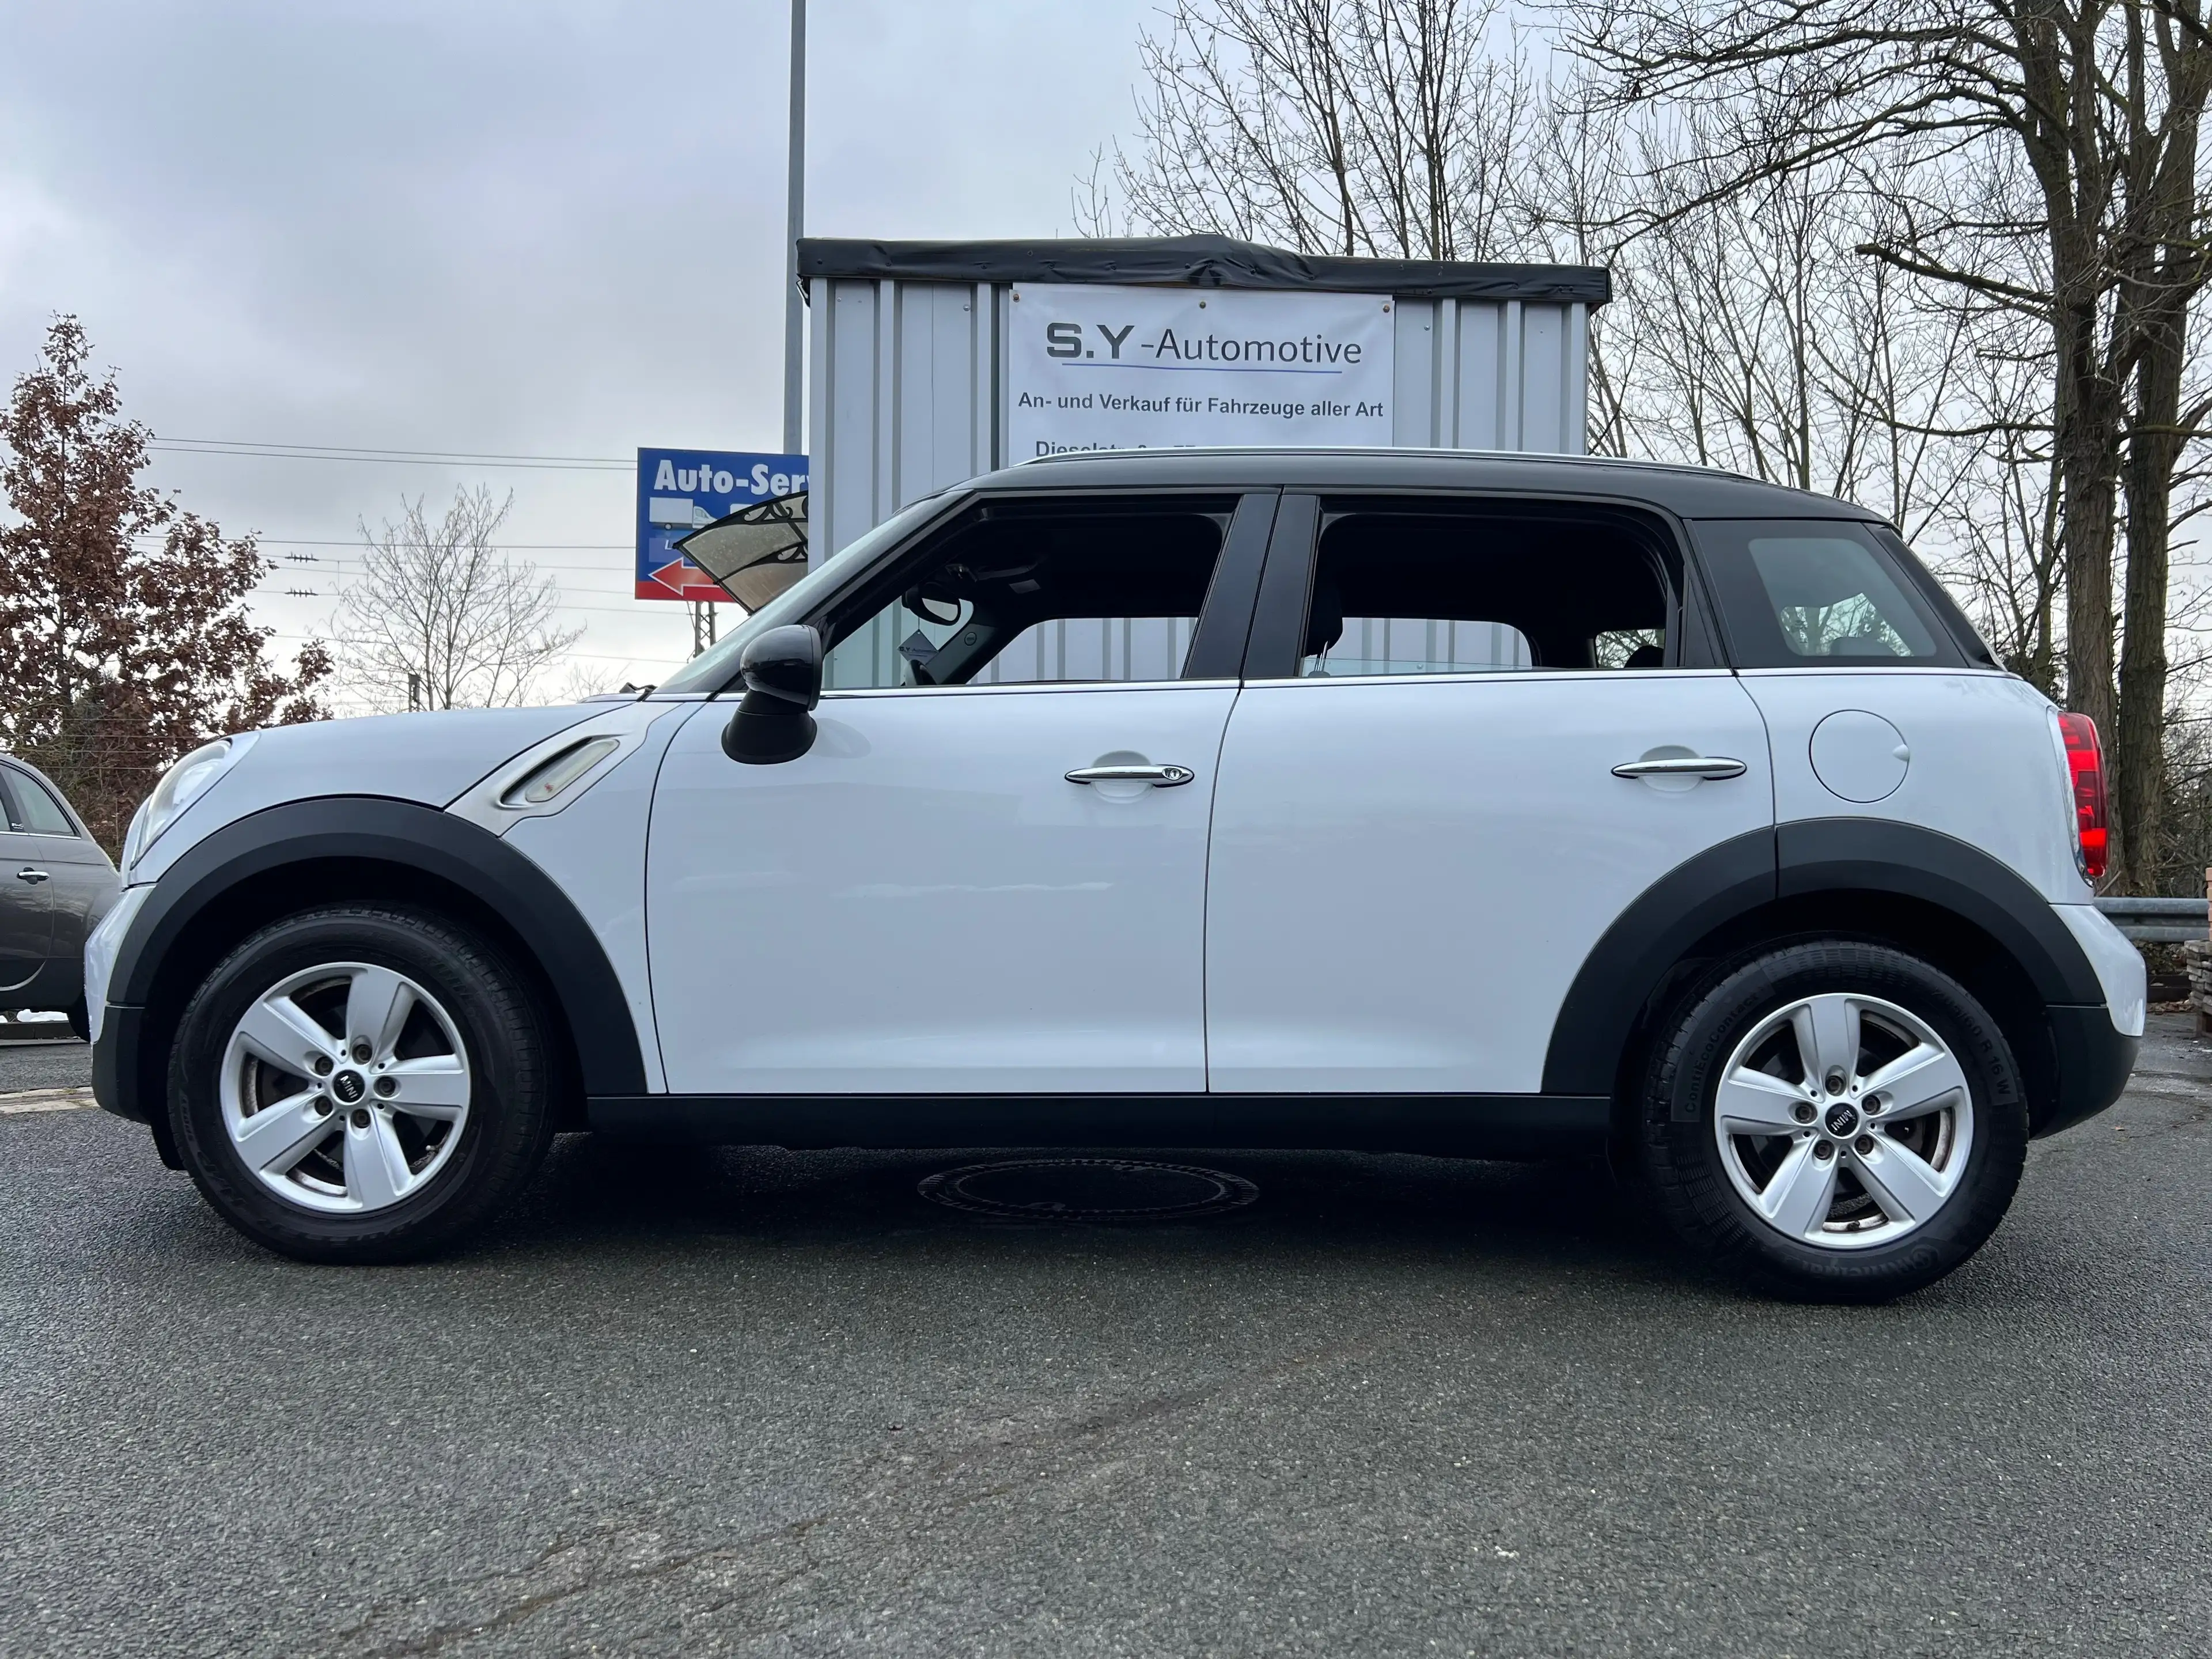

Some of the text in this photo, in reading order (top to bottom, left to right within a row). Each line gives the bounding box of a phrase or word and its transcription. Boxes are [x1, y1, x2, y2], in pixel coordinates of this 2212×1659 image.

[1018, 392, 1384, 419] An- und Verkauf für Fahrzeuge aller Art
[654, 460, 809, 496] Auto-Ser
[339, 1075, 358, 1099] MINI
[1831, 1109, 1853, 1131] MINI
